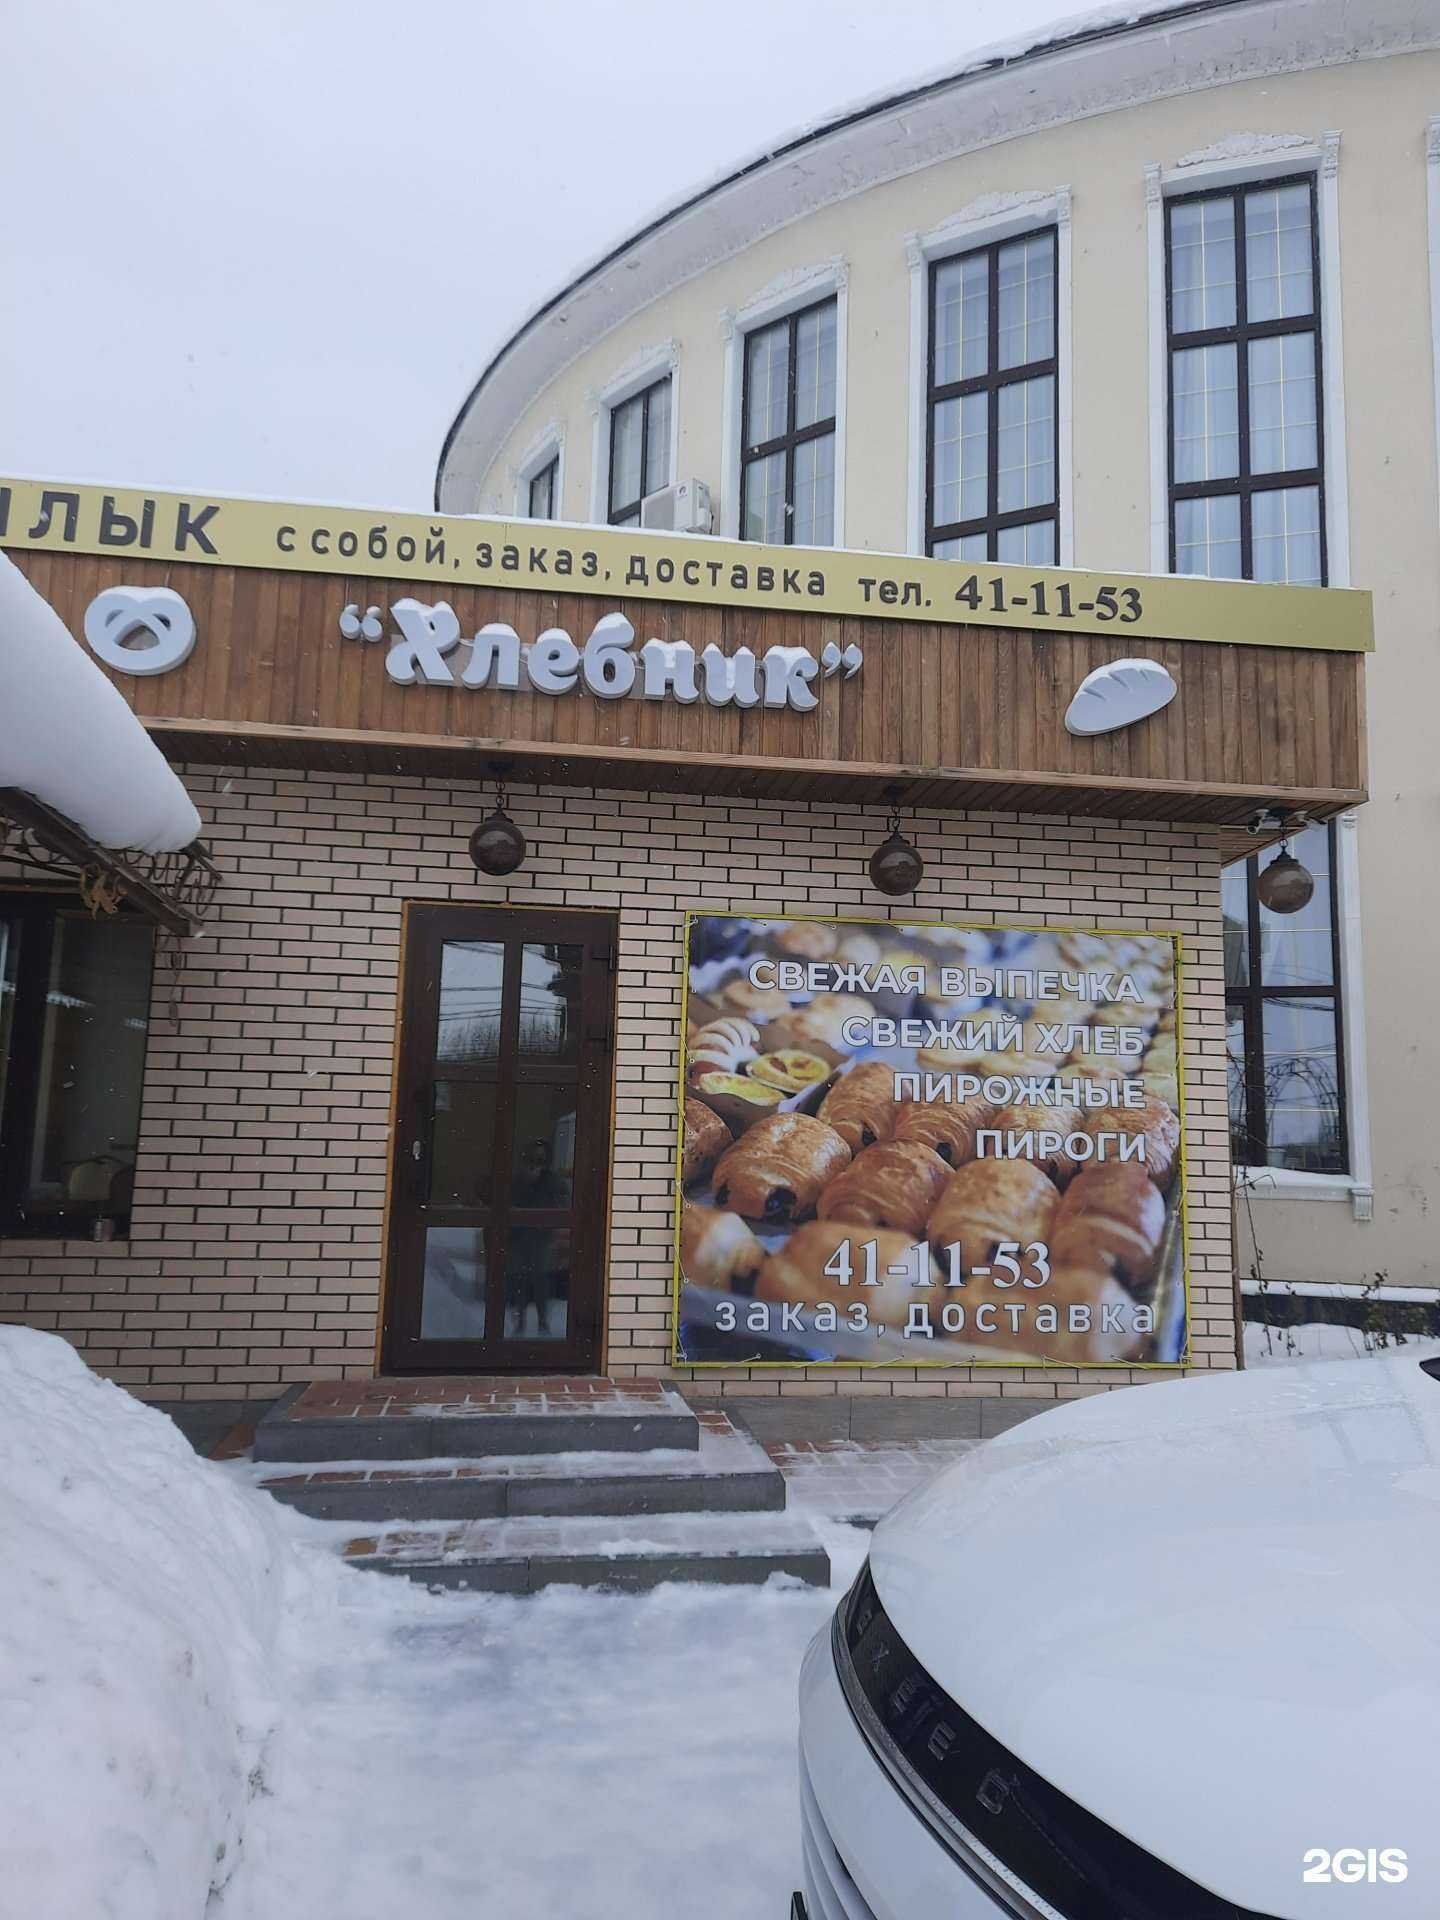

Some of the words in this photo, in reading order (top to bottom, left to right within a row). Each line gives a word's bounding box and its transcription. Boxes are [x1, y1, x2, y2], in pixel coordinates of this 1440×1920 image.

[310, 525, 461, 570] собой,
[475, 542, 612, 582] заказ,
[625, 554, 826, 596] доставка
[857, 576, 932, 607] тел.
[954, 574, 1144, 623] 41-11-53
[748, 959, 926, 995] СВЕЖАЯ
[939, 966, 1144, 1004] ВЫПЕЧКА
[841, 1014, 1024, 1053] СВЕЖИЙ
[1034, 1023, 1144, 1057] ХЛЕБ
[893, 1071, 1147, 1110] ПИРОЖНЫЕ
[975, 1129, 1147, 1162] ПИРОГИ
[822, 1238, 1051, 1289] 41-11-53
[714, 1300, 887, 1337] заказ,
[902, 1301, 1156, 1339] доставка
